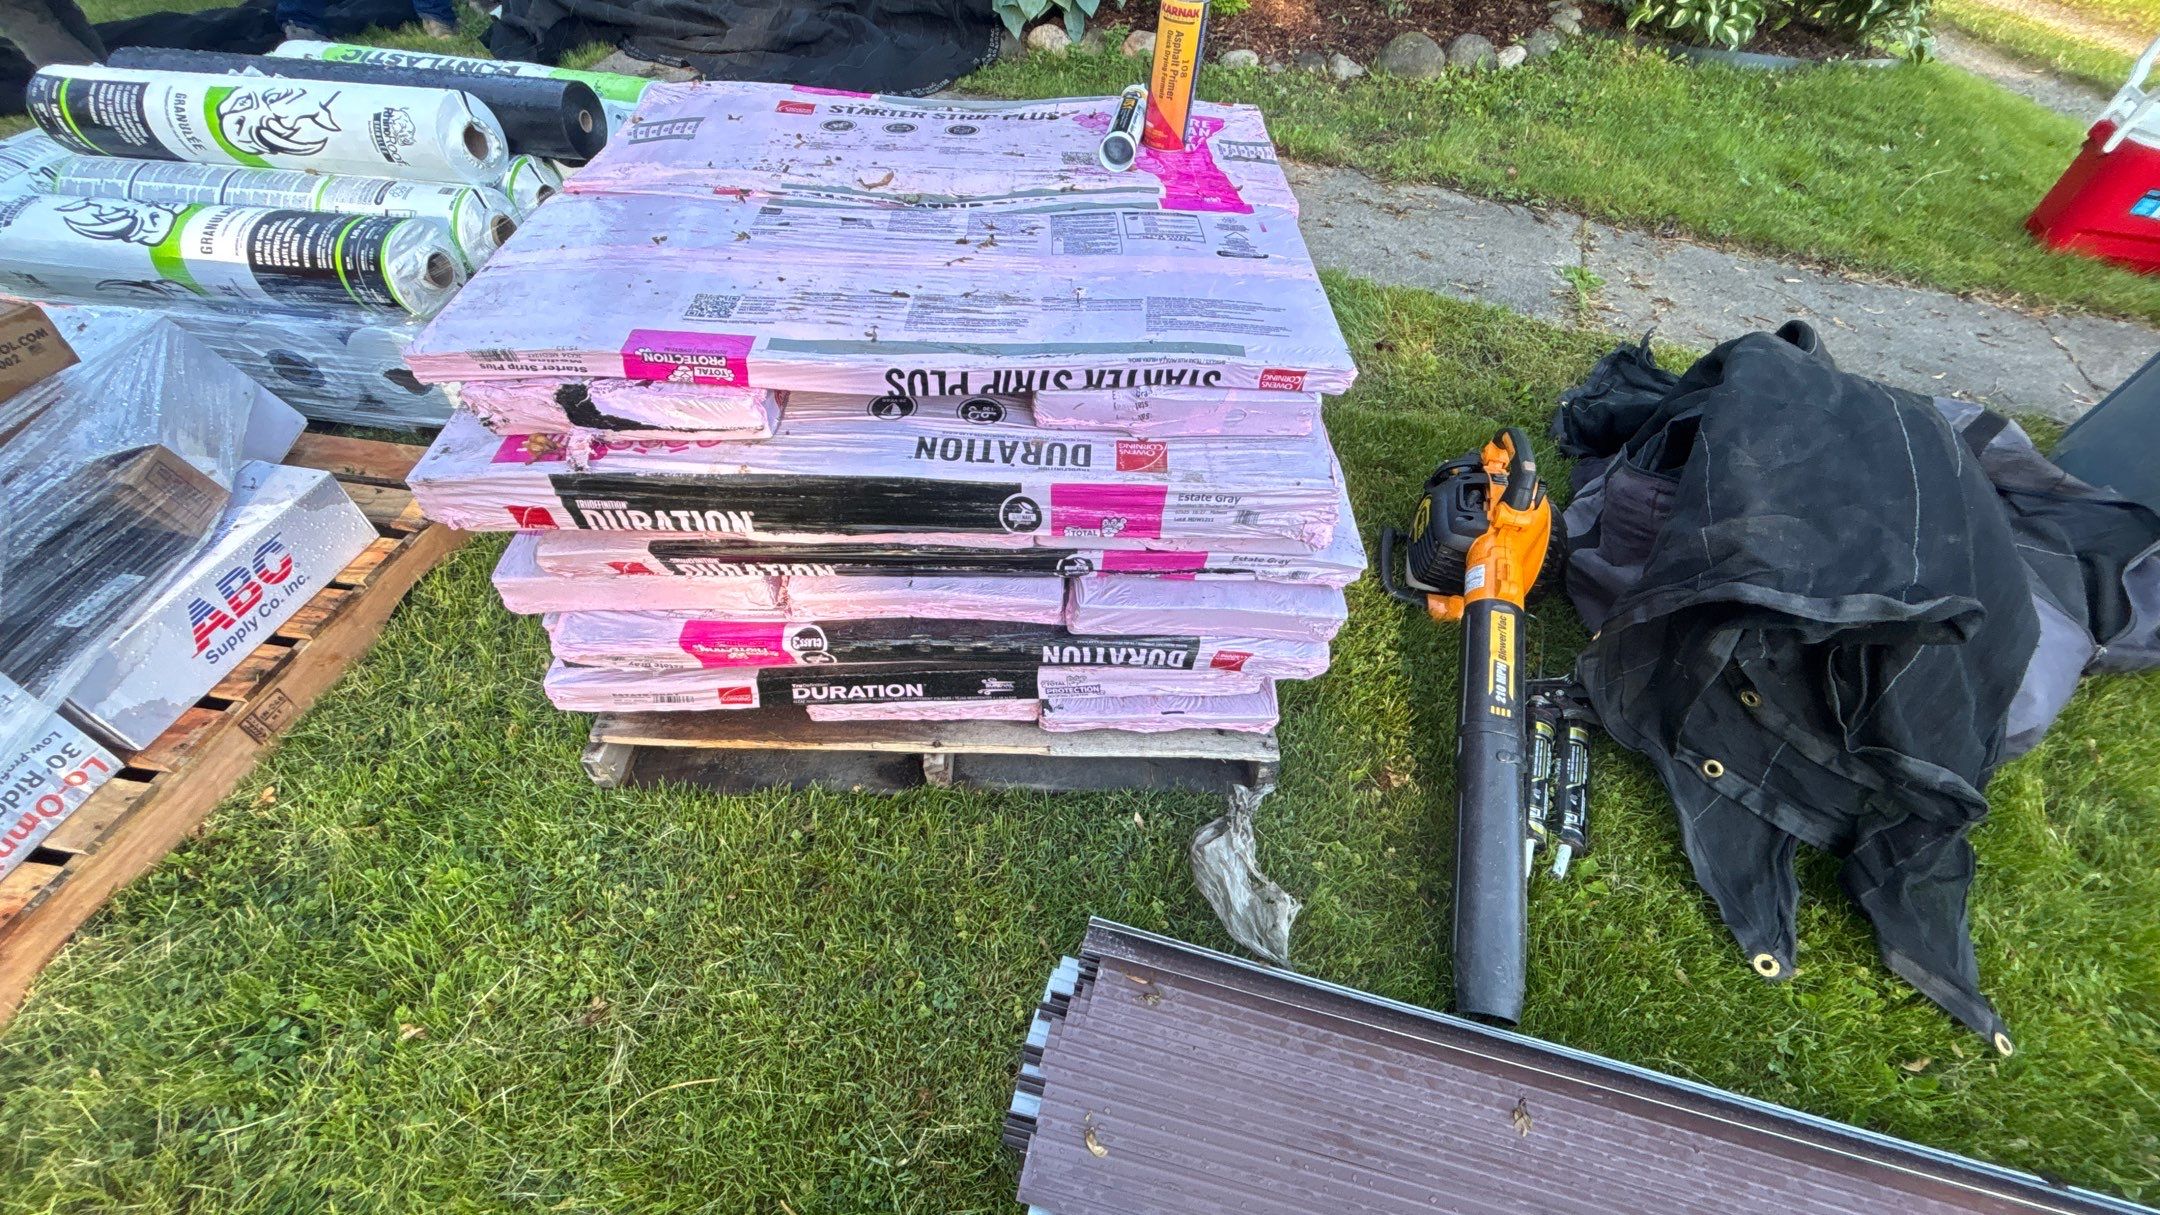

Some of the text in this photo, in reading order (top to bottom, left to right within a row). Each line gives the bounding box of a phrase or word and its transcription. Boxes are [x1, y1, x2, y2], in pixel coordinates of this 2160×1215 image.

[1162, 2, 1200, 18] KARNAK
[1159, 30, 1174, 99] Quick Drying Formula
[1166, 30, 1185, 101] Asphalt Primer
[1180, 59, 1190, 78] 108
[828, 104, 927, 119] STARTER
[174, 92, 208, 151] GRANULÉE
[479, 363, 505, 371] Plus
[643, 353, 726, 365] PROTECTION
[542, 365, 587, 373] Starter
[697, 368, 726, 376] TOTAL
[885, 369, 967, 397] PLUS
[980, 370, 1073, 393] STRIP
[1263, 375, 1301, 383] CORNING
[914, 435, 1092, 467] DURATION
[1178, 493, 1241, 505] Estate Gray
[582, 510, 754, 533] DURATION
[1072, 529, 1098, 537] TOTAL
[1267, 557, 1292, 565] Gray
[187, 531, 293, 659] ABC
[205, 574, 311, 665] Supply Co. inc.
[792, 637, 822, 649] CLASS 3
[1042, 646, 1187, 667] DURATION
[1495, 616, 1508, 704] 210 MPH Blower/Vac
[792, 684, 924, 700] DURATION
[1047, 685, 1100, 694] PROTECTION
[0, 730, 63, 785] Low-Profi
[0, 756, 110, 871] Lo-Omn
